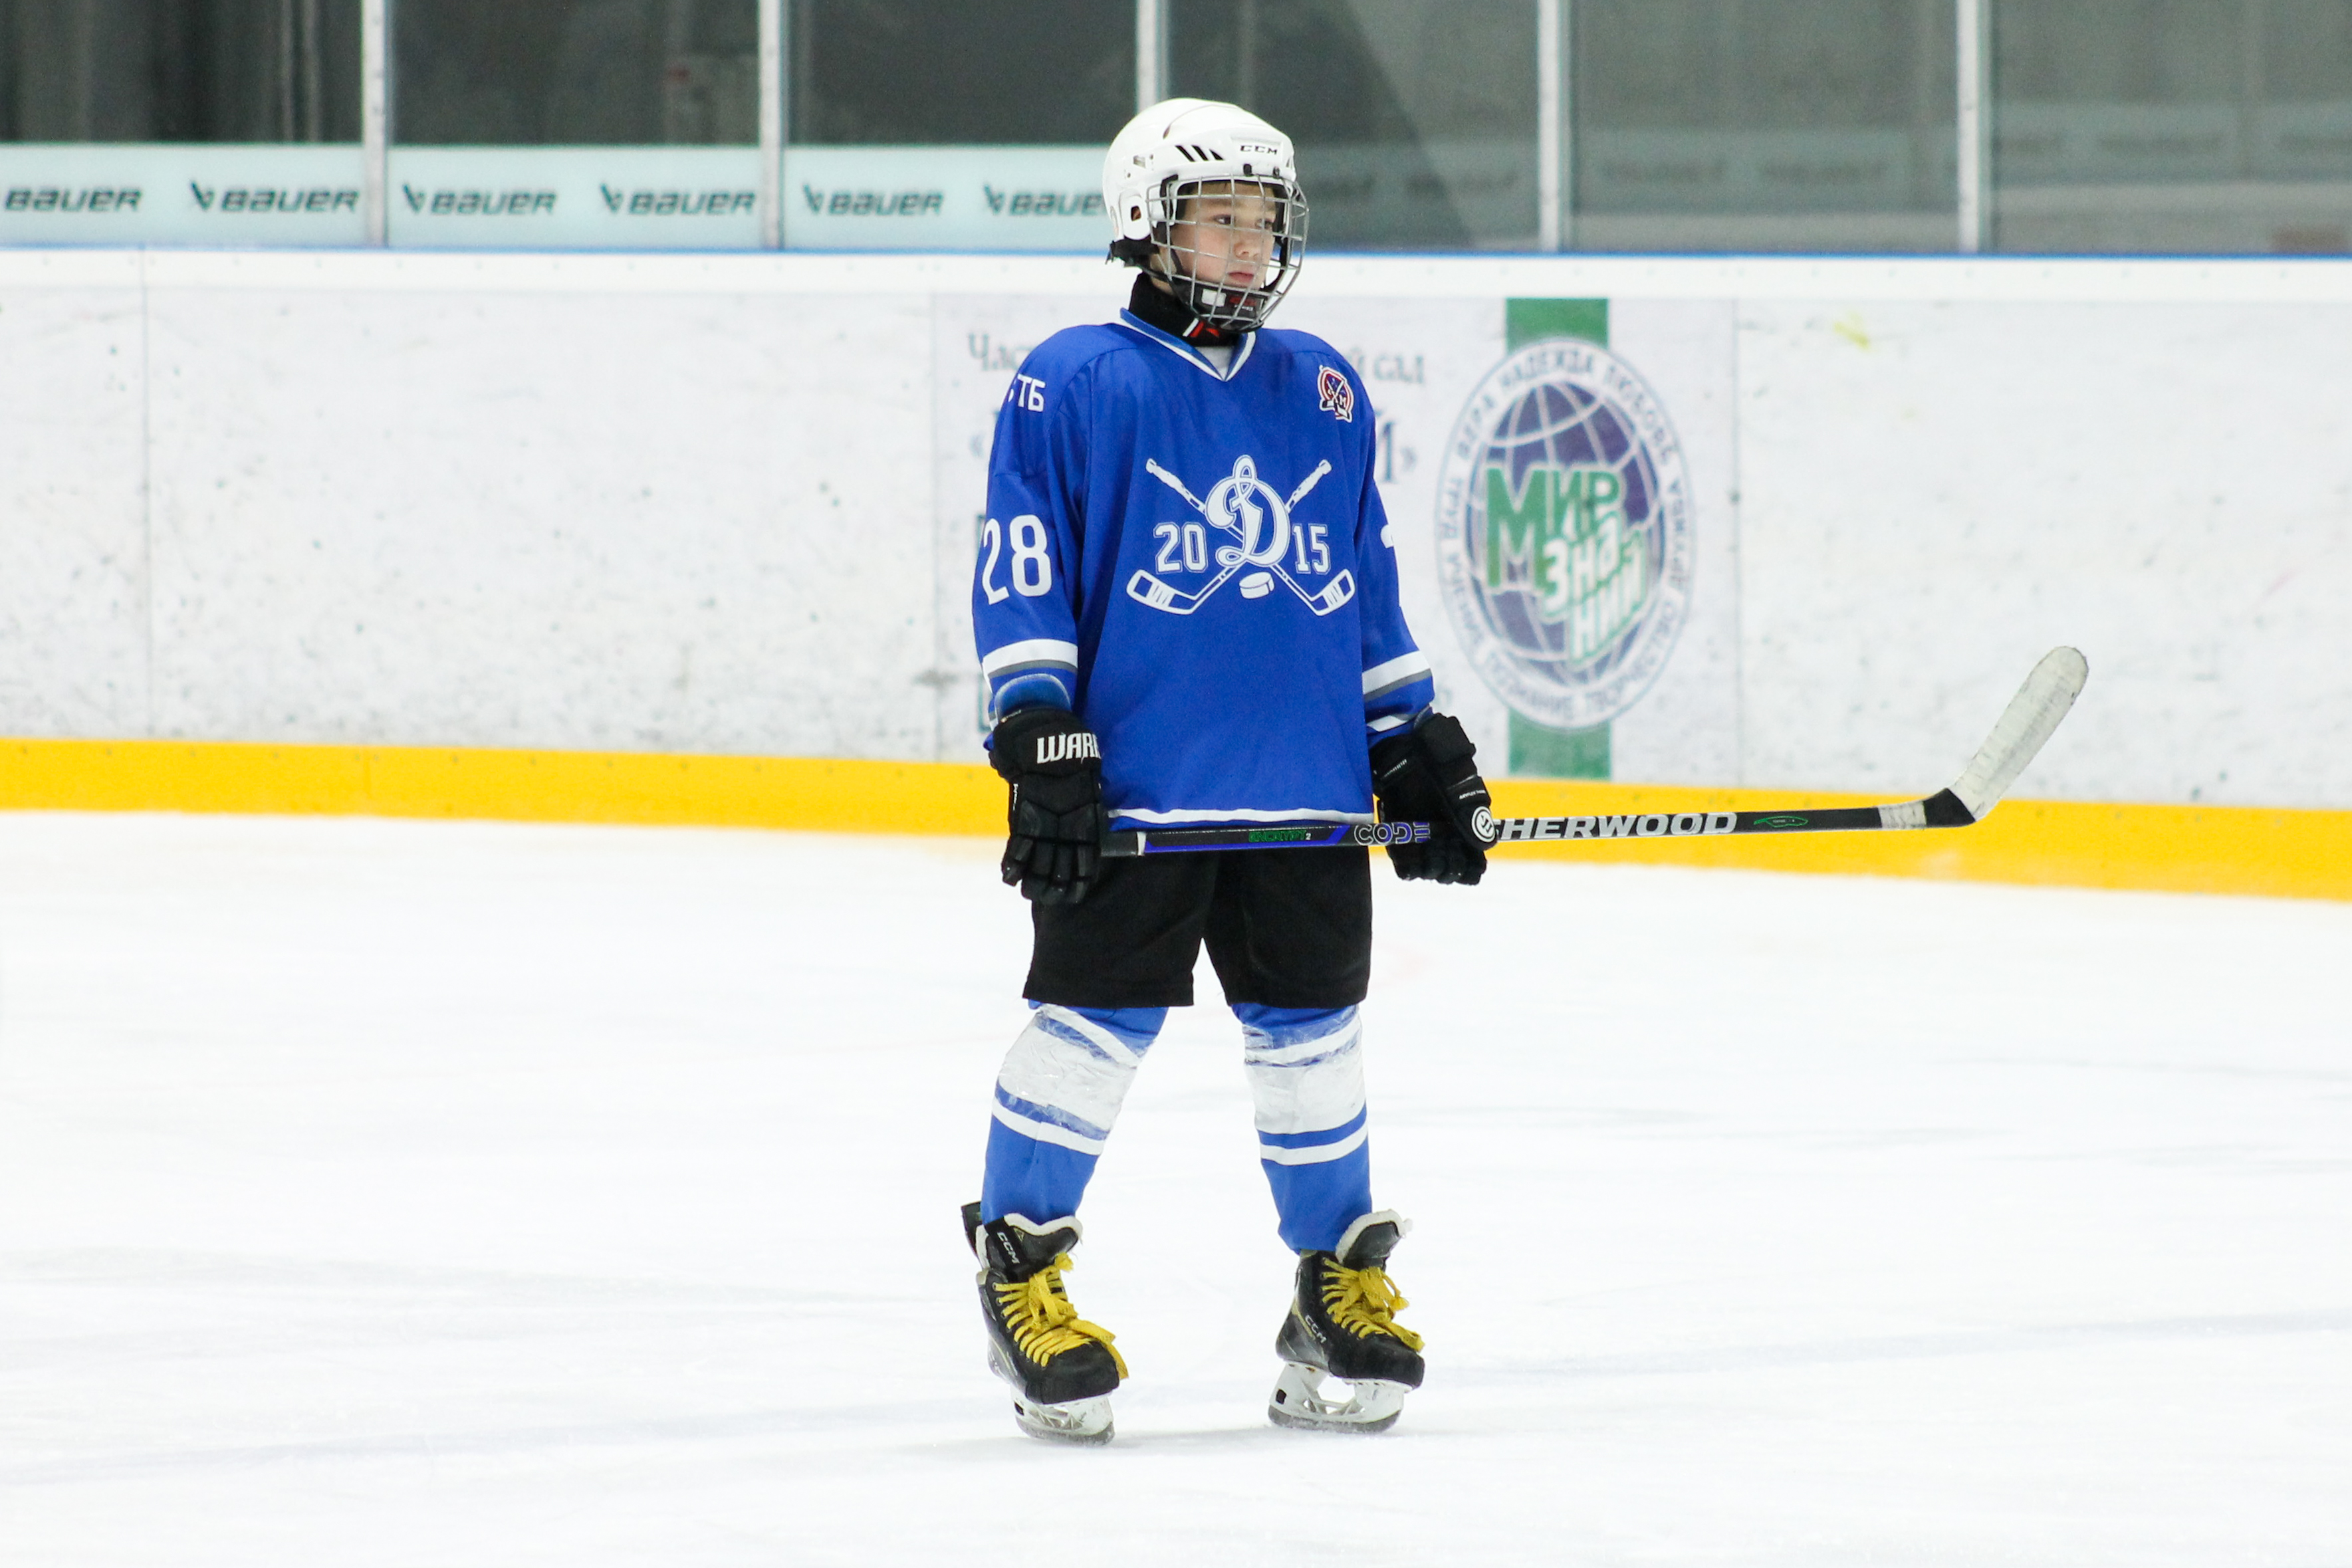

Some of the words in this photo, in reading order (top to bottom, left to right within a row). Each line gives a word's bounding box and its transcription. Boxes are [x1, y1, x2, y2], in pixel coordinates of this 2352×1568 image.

[1240, 145, 1278, 155] CCM
[1009, 192, 1107, 216] BAUE
[1008, 374, 1046, 412] ТБ
[982, 514, 1052, 605] 28
[1153, 522, 1208, 574] 20
[1292, 523, 1331, 575] 15
[1354, 822, 1431, 846] CODE
[997, 1232, 1020, 1264] CCM
[1305, 1315, 1327, 1343] CCM
